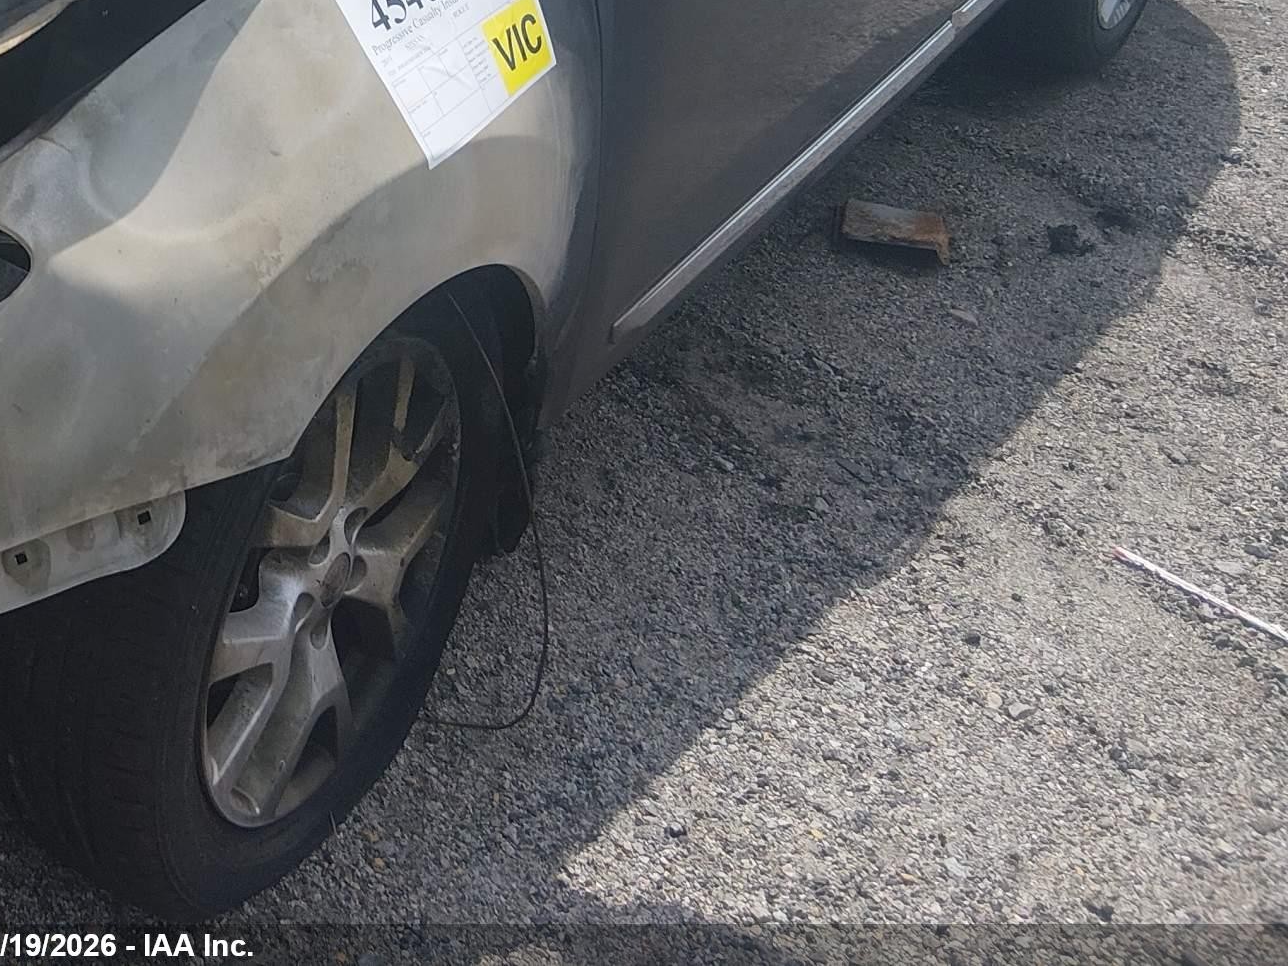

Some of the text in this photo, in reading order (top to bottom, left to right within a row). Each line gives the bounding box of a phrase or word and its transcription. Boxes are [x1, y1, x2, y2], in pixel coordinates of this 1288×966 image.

[371, 24, 413, 55] Progressive
[412, 6, 442, 29] Casualty
[492, 13, 542, 71] VIC
